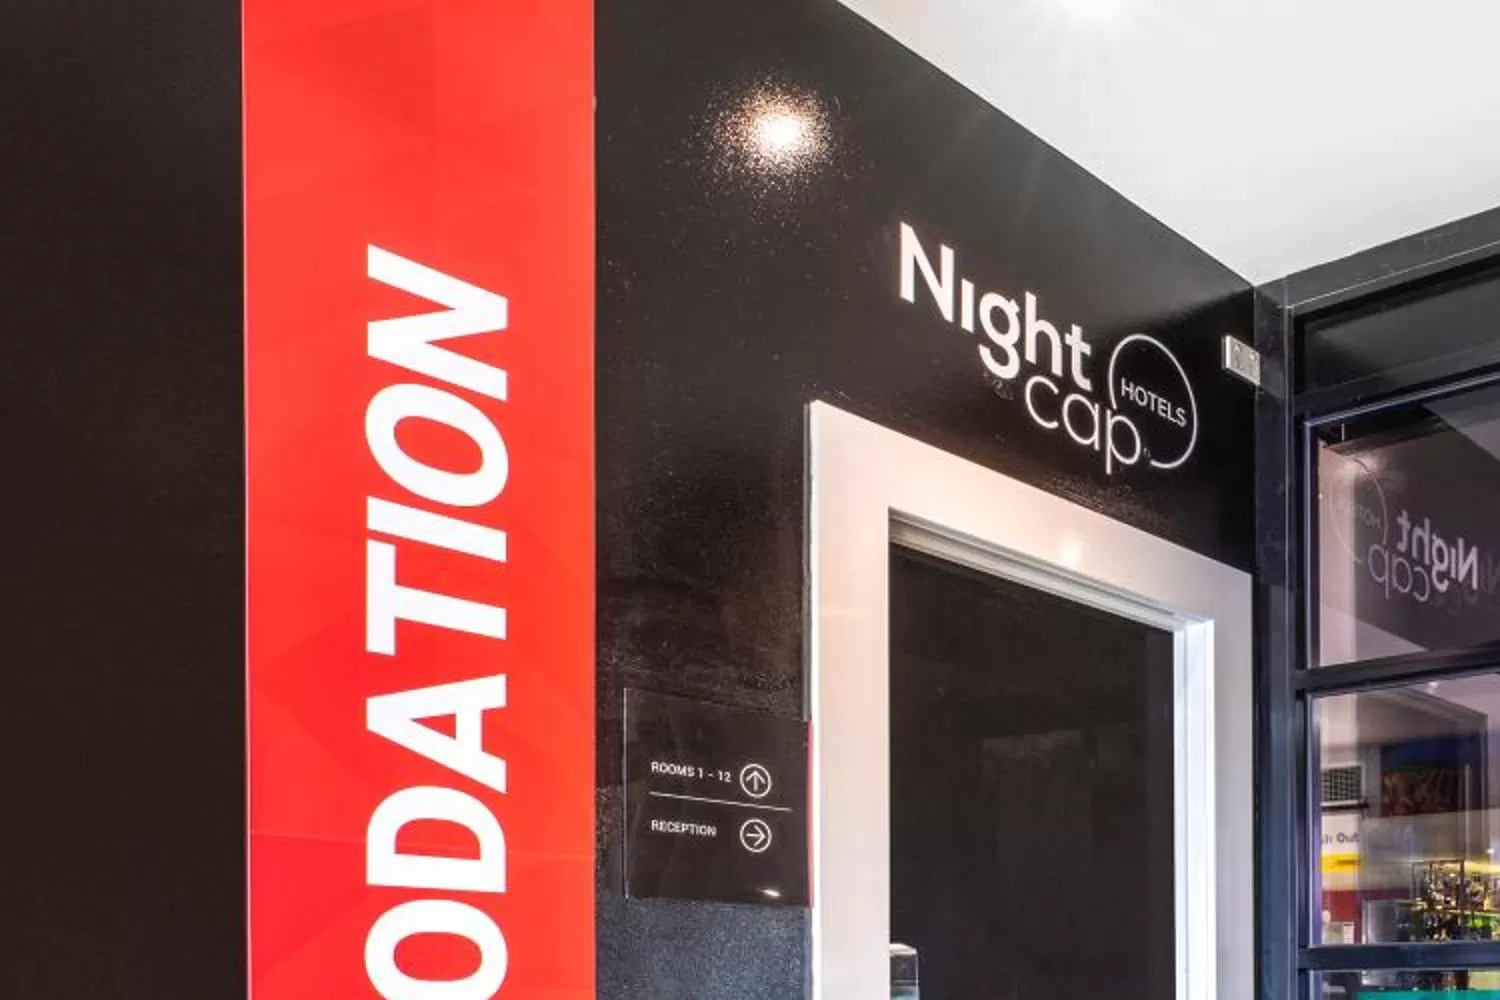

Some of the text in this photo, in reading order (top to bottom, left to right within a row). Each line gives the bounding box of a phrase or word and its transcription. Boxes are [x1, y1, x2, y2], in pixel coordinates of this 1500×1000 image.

[899, 220, 1093, 392] Night
[1025, 375, 1142, 475] cap
[1120, 376, 1188, 428] HOTELS
[651, 761, 694, 777] ROOMS
[698, 767, 704, 779] 1
[718, 771, 731, 783] 12
[651, 819, 717, 837] RECEPTION
